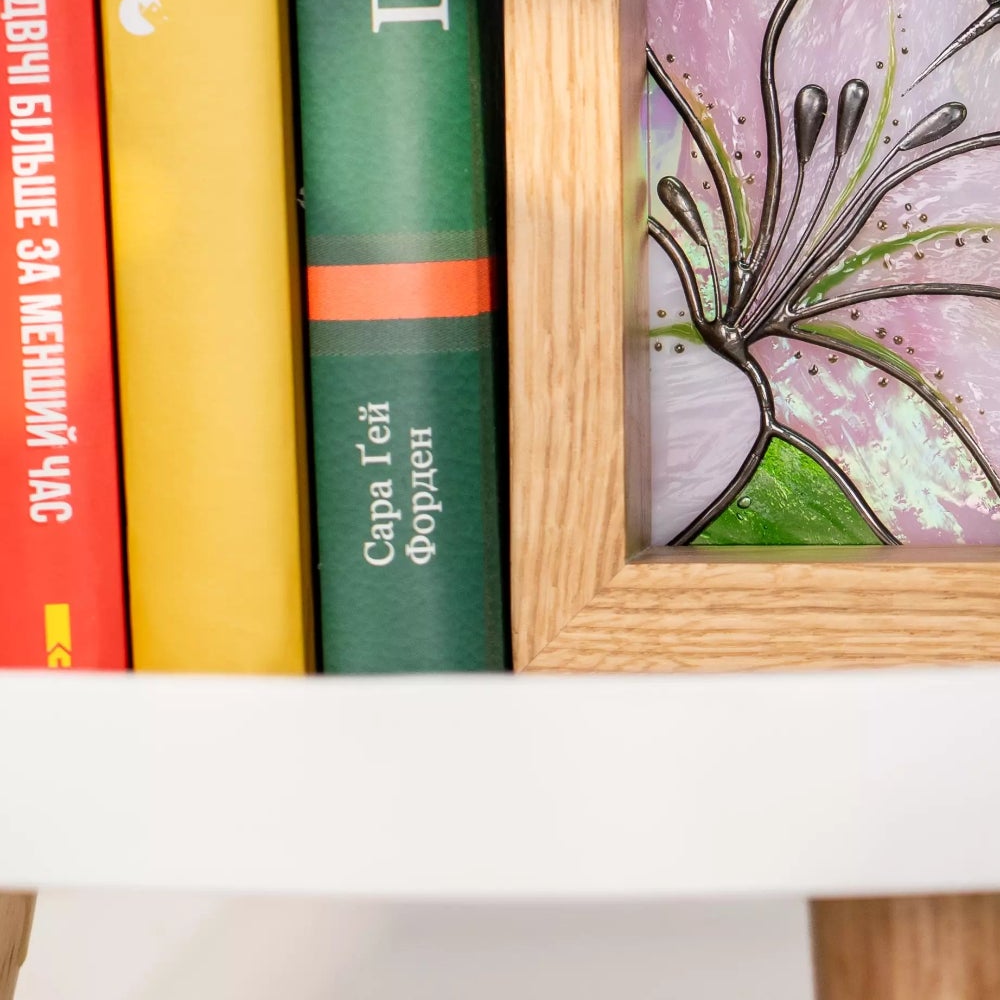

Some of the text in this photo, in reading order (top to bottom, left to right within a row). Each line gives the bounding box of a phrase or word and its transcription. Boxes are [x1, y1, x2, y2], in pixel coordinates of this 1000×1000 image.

[10, 95, 58, 228] БІЛЬШЕ
[17, 238, 61, 285] ЗА
[19, 294, 77, 447] МЕНШИЙ
[29, 456, 72, 523] ЧАС
[356, 402, 402, 566] Сара Ґей
[405, 427, 442, 565] Форден
